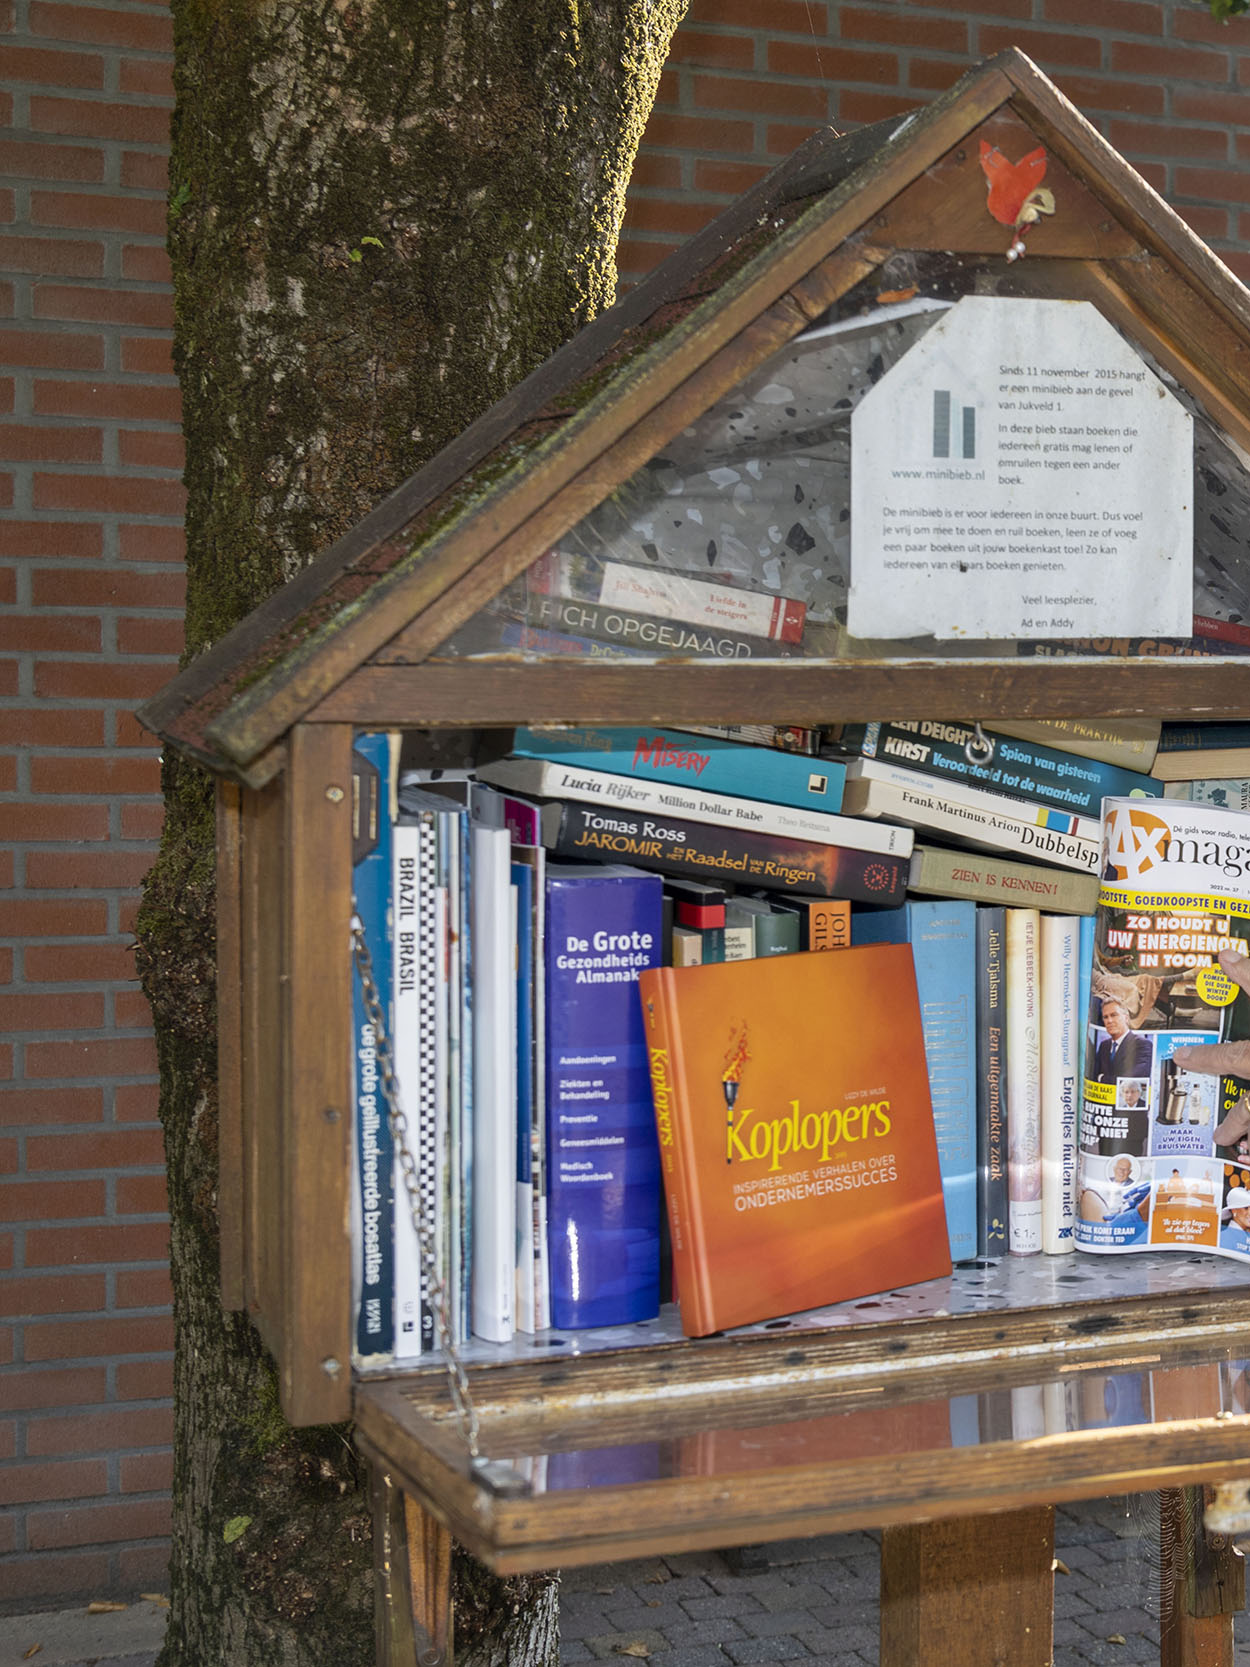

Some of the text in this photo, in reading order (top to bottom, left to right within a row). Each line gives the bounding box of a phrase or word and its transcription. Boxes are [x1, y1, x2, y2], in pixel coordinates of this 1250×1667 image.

[999, 365, 1146, 382] Sinds 11 november 2015 hangt
[1011, 385, 1030, 393] een
[1032, 384, 1074, 394] minibieb
[1076, 387, 1093, 395] aan
[1095, 386, 1107, 395] de
[1108, 387, 1134, 398] gevel
[998, 401, 1016, 409] van
[998, 424, 1138, 436] In deze bieb staan boeken die
[998, 440, 1133, 454] iedereen gratis mag lenen of
[891, 469, 986, 481] www.minibieb.nl
[998, 458, 1120, 470] omruilen tegen een ander
[883, 507, 897, 517] De
[899, 507, 943, 518] minibieb
[954, 510, 963, 518] er
[966, 510, 987, 518] voor
[990, 509, 1032, 519] iedereen
[1035, 510, 1044, 519] in
[1046, 511, 1069, 520] onze
[1102, 511, 1121, 520] Dus
[1123, 512, 1143, 521] voel
[882, 525, 1138, 540] je vrij om mee te doen en ruil boeken, leen ze of voeg
[883, 543, 1117, 554] een paar boeken uit jouw boekenkast Zo kan
[883, 560, 929, 570] iedereen
[931, 561, 948, 569] van
[986, 560, 1021, 570] boeken
[1022, 595, 1042, 604] Veel
[604, 614, 752, 657] OPGEJAAGD
[1021, 618, 1074, 629] Ad en Addy
[884, 736, 931, 763] KIRST
[1000, 744, 1101, 783] Spion van gisteren
[932, 752, 1002, 782] Veroordeeld
[1002, 771, 1020, 788] tot
[1020, 776, 1036, 792] de
[1037, 782, 1091, 807] waarheid
[561, 774, 764, 822] Lucia Rijker Million Dollar Babe
[1241, 782, 1249, 810] MAURA
[581, 811, 686, 843] Tomas Ross
[902, 791, 1099, 870] Frank Martinus Arion Dubbelsp
[1184, 826, 1199, 835] gids
[1201, 828, 1216, 836] voor
[1218, 829, 1238, 840] radio,
[574, 831, 663, 858] JAROMIR
[685, 849, 748, 871] Raadsel
[764, 861, 816, 885] Ringen
[399, 857, 415, 921] BRAZIL
[952, 867, 1059, 895] ZIEN IS KENNEN!
[1135, 895, 1210, 908] GOEDKOOPSTE
[1213, 900, 1226, 910] EN
[1127, 915, 1229, 934] ZO HOUDT U
[566, 931, 653, 952] De Grote
[1108, 930, 1249, 957] UW ENERGIENOTA
[399, 931, 415, 996] BRASIL
[557, 952, 650, 969] Gezondheids
[1139, 954, 1213, 968] IN TOOM
[576, 967, 640, 984] Almanak
[1026, 947, 1034, 1018] LIEBEEK-HOVING
[987, 929, 1003, 1181] Jelle Tjalsma Een uitgemaakte zaak
[360, 1047, 381, 1093] grote
[1061, 934, 1075, 1217] Willy Engeltjes huilen niet
[650, 1048, 674, 1146] Koplopers
[1094, 1116, 1128, 1128] ONZE
[1100, 1127, 1129, 1139] NIET
[728, 1099, 891, 1172] Koplopers
[733, 1171, 810, 1195] INSPIRERENDE
[812, 1159, 866, 1179] VERHALEN
[868, 1154, 896, 1168] OVER
[734, 1167, 898, 1212] ONDERNEMERSSUCCES
[363, 1211, 382, 1285] bosatlas
